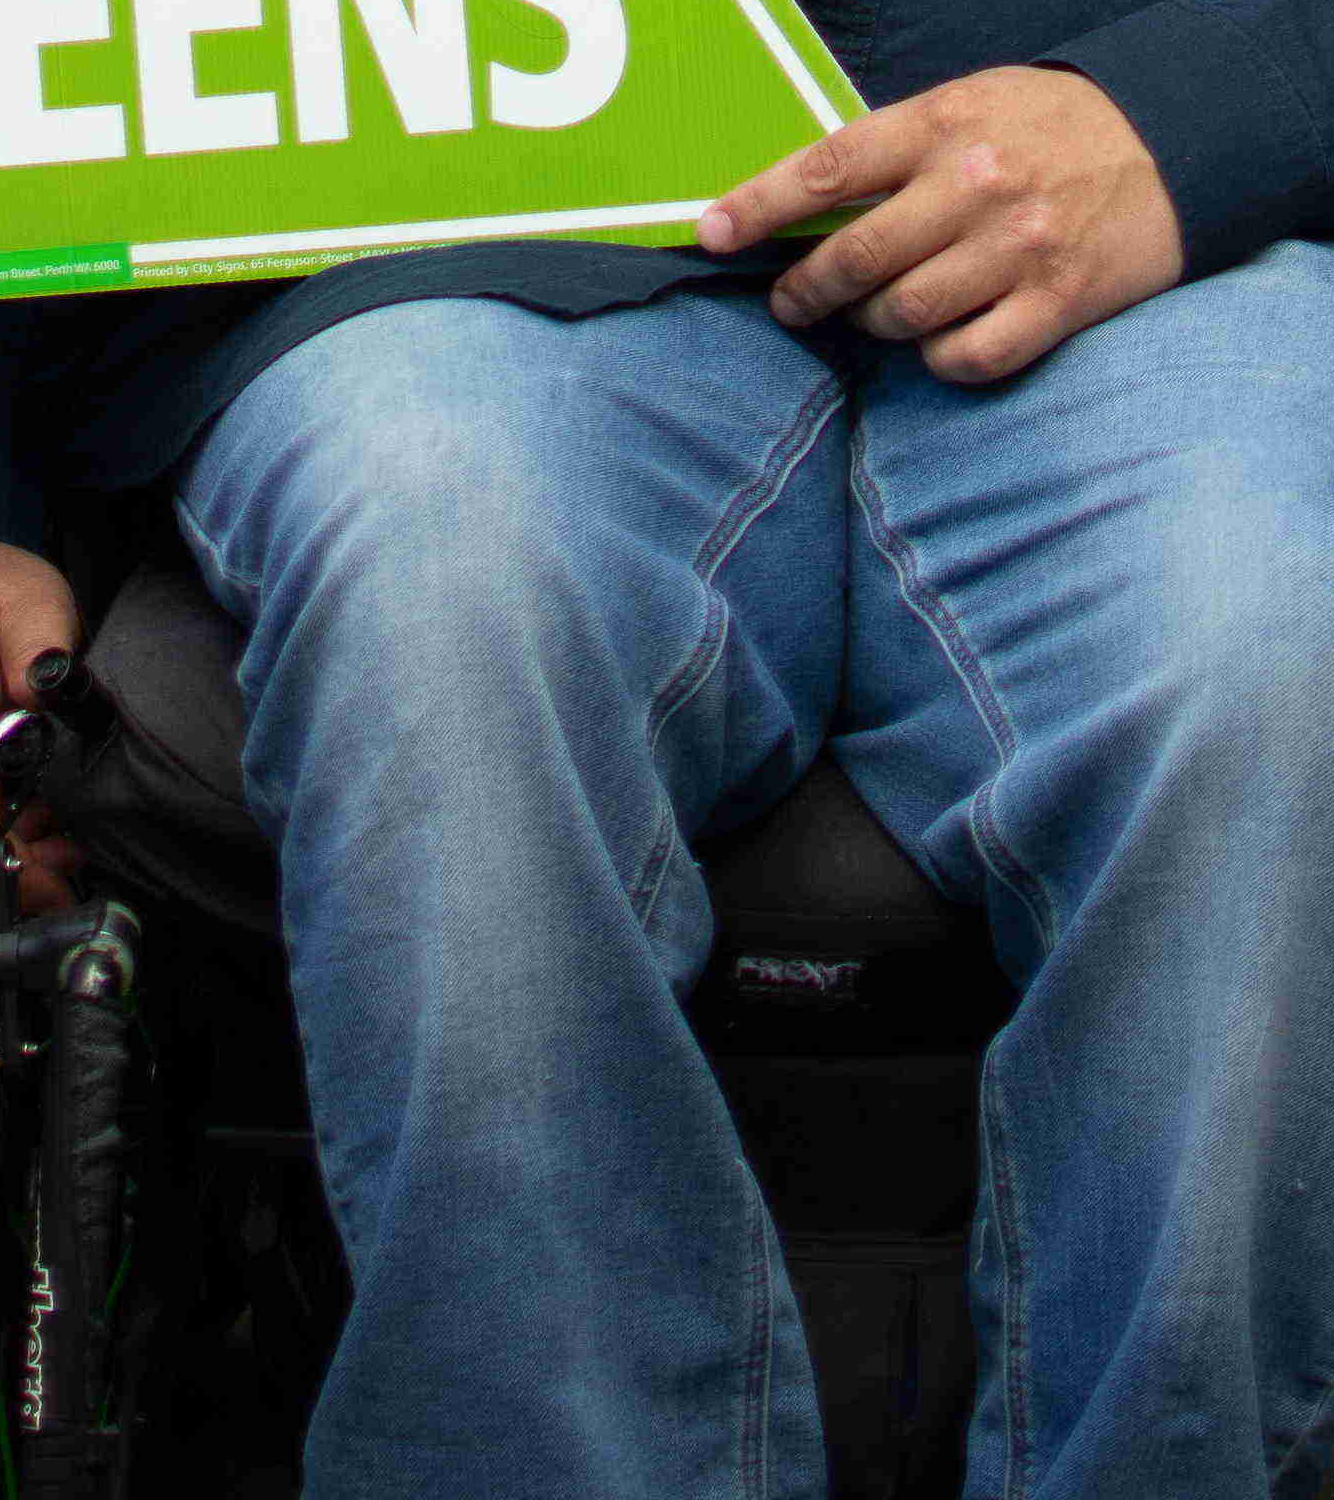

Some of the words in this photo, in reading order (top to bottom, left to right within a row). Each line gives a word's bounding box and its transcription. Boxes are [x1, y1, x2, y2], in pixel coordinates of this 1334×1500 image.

[132, 266, 175, 279] Printed
[177, 265, 188, 277] by
[250, 258, 264, 269] 65
[266, 253, 317, 270] Ferguson
